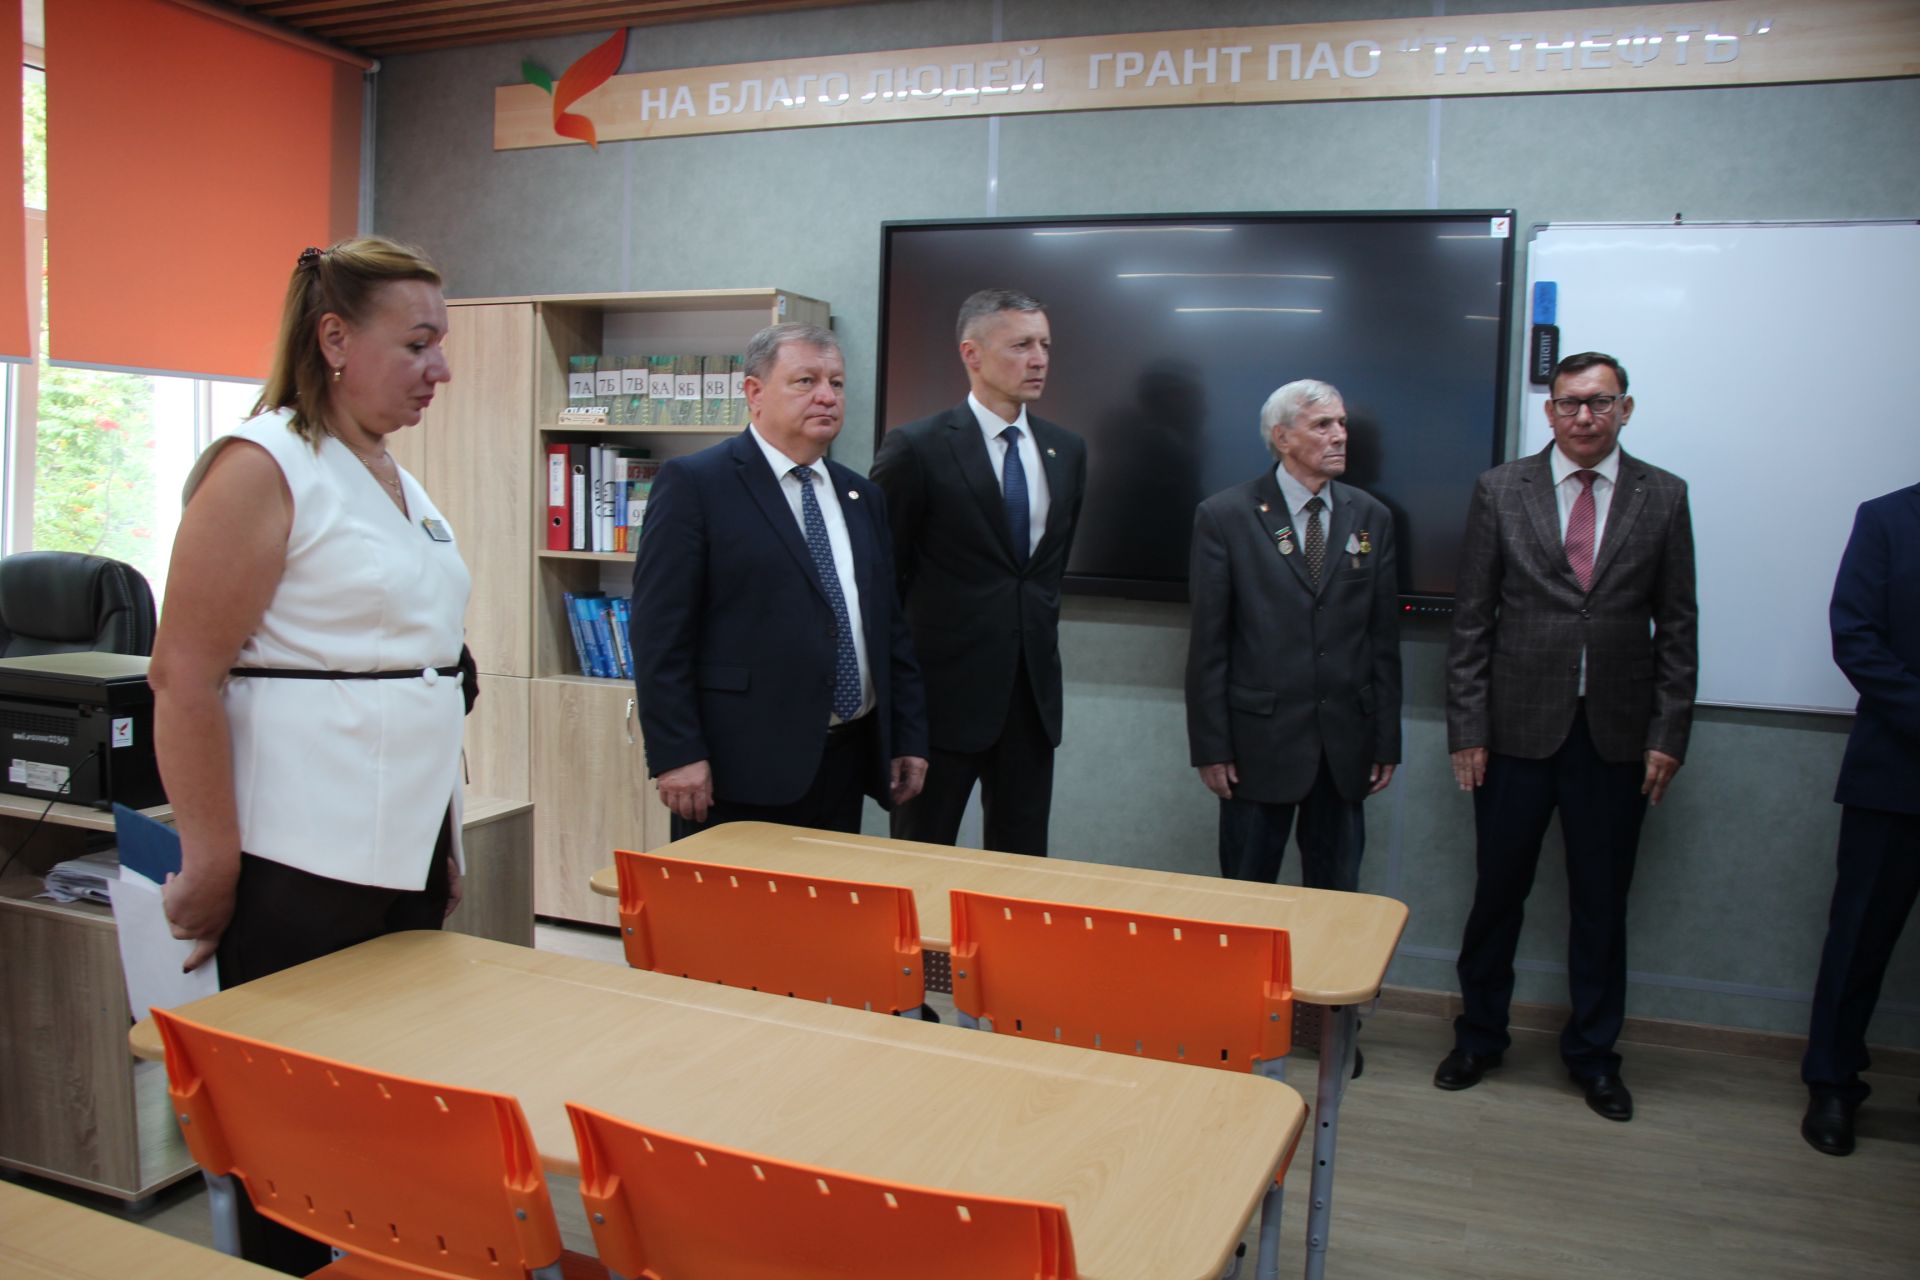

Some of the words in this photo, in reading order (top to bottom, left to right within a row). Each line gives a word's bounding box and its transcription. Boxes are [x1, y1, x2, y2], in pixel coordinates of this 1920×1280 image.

[641, 85, 697, 121] НА
[708, 72, 850, 116] БЛАГО
[861, 46, 1046, 106] ЛЮДЕЙ
[1088, 46, 1253, 90] ГРАНТ
[1267, 40, 1381, 81] ПАО
